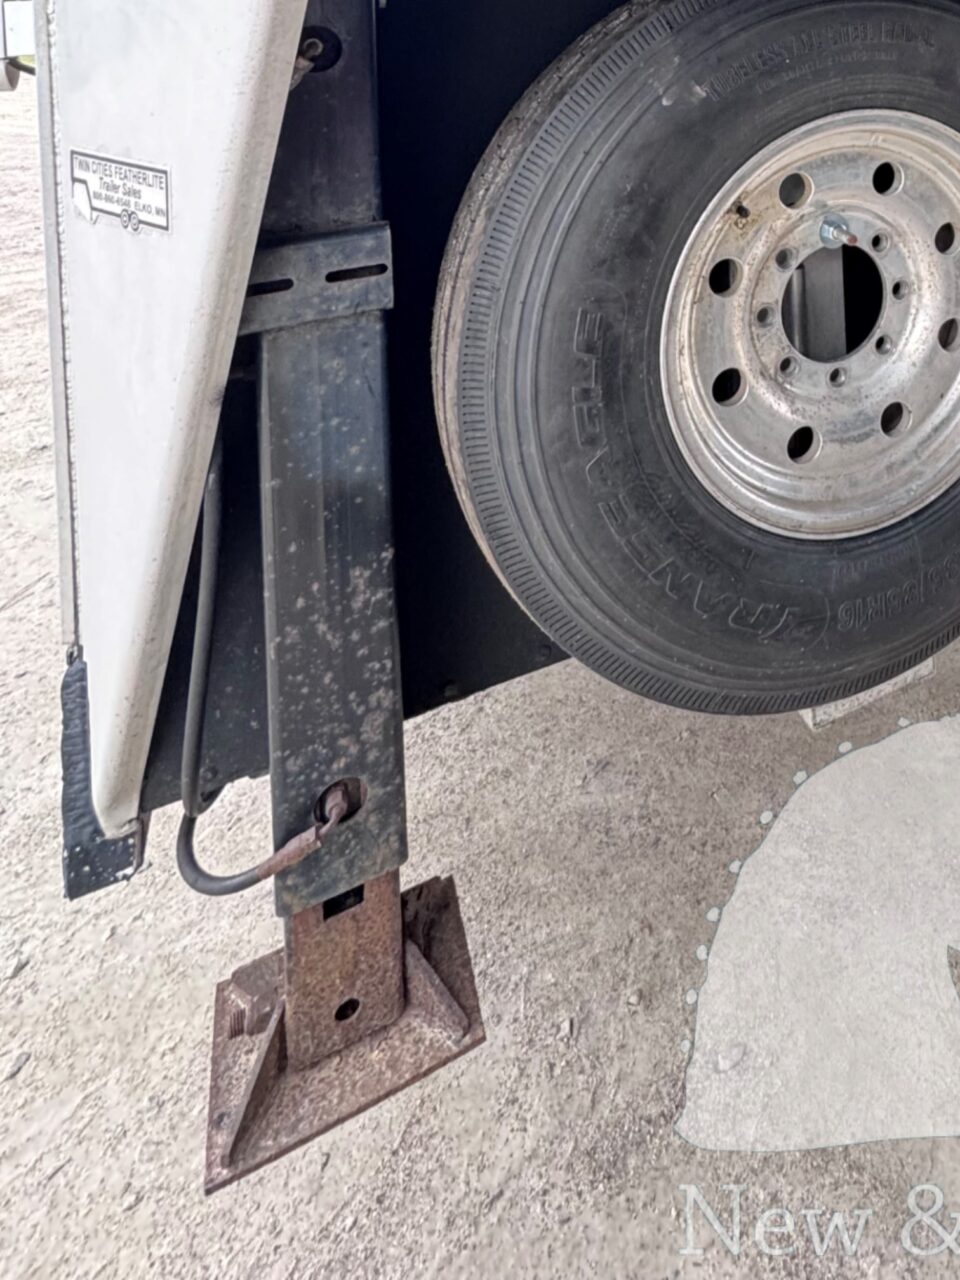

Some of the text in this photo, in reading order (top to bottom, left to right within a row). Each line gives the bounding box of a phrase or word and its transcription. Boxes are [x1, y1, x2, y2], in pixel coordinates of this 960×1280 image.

[74, 156, 165, 190] TWIN CITIES FEATHERLITE
[99, 177, 142, 199] Trailer Sales
